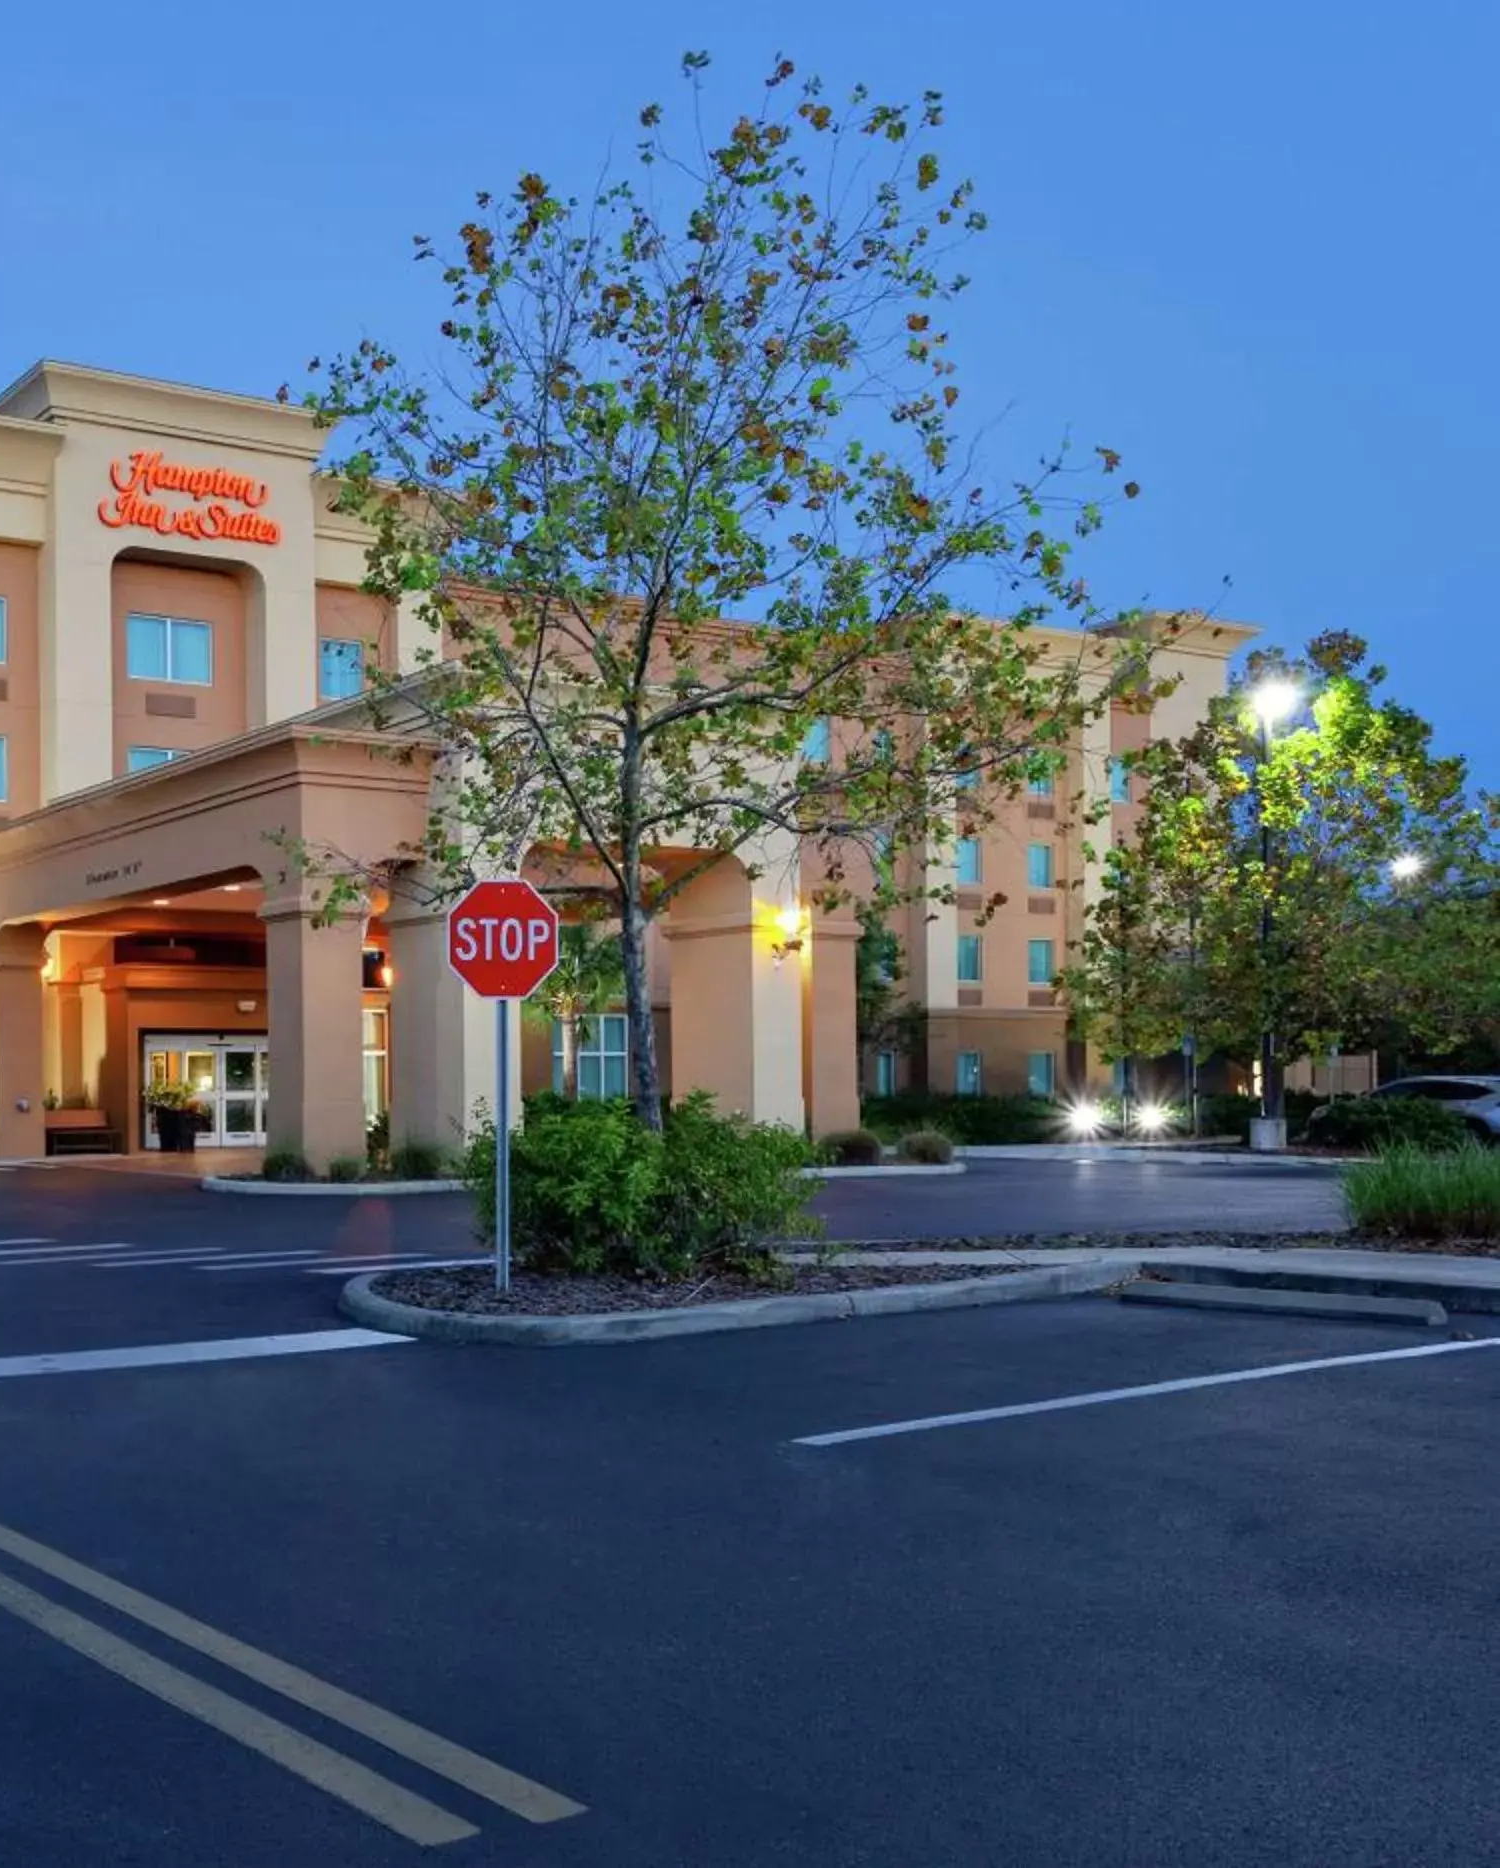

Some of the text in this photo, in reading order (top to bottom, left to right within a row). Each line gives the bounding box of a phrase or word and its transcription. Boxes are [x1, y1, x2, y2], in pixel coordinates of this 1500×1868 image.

[110, 452, 267, 507] Hampton
[98, 491, 280, 544] Inn & Suites
[455, 917, 550, 961] STOP
